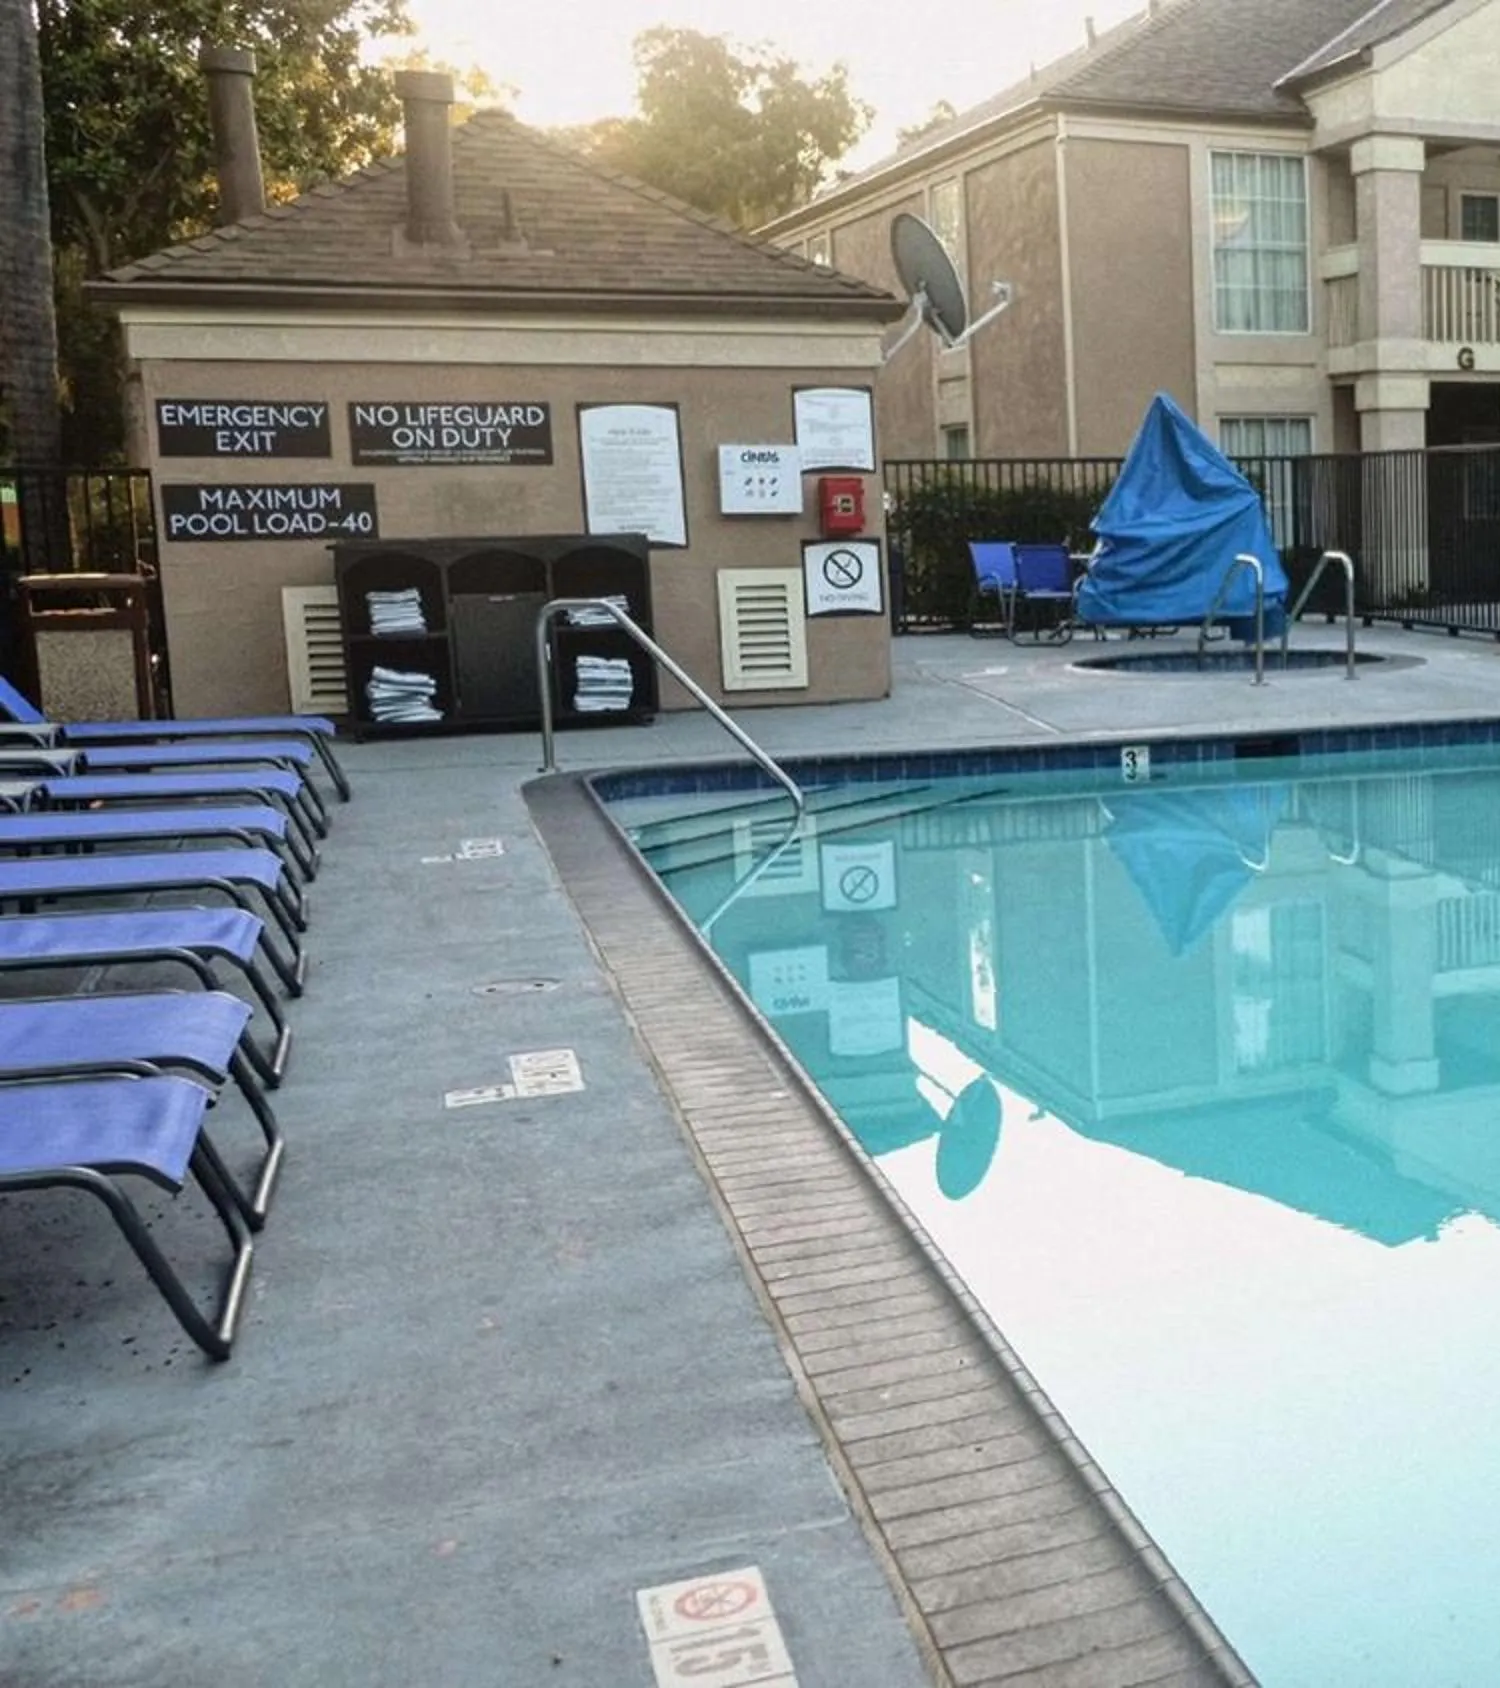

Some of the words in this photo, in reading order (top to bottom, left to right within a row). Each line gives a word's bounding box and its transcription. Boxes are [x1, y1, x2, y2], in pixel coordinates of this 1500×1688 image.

[1457, 346, 1475, 370] G
[161, 404, 325, 429] EMERGENCY
[355, 405, 399, 426] NO
[405, 405, 545, 426] LIFEGUARD
[216, 430, 276, 452] EXIT
[392, 427, 435, 448] ON
[442, 427, 512, 448] DUTY
[200, 487, 342, 510] MAXIMUM
[170, 513, 249, 535] POOL
[253, 511, 373, 534] LOAD-40
